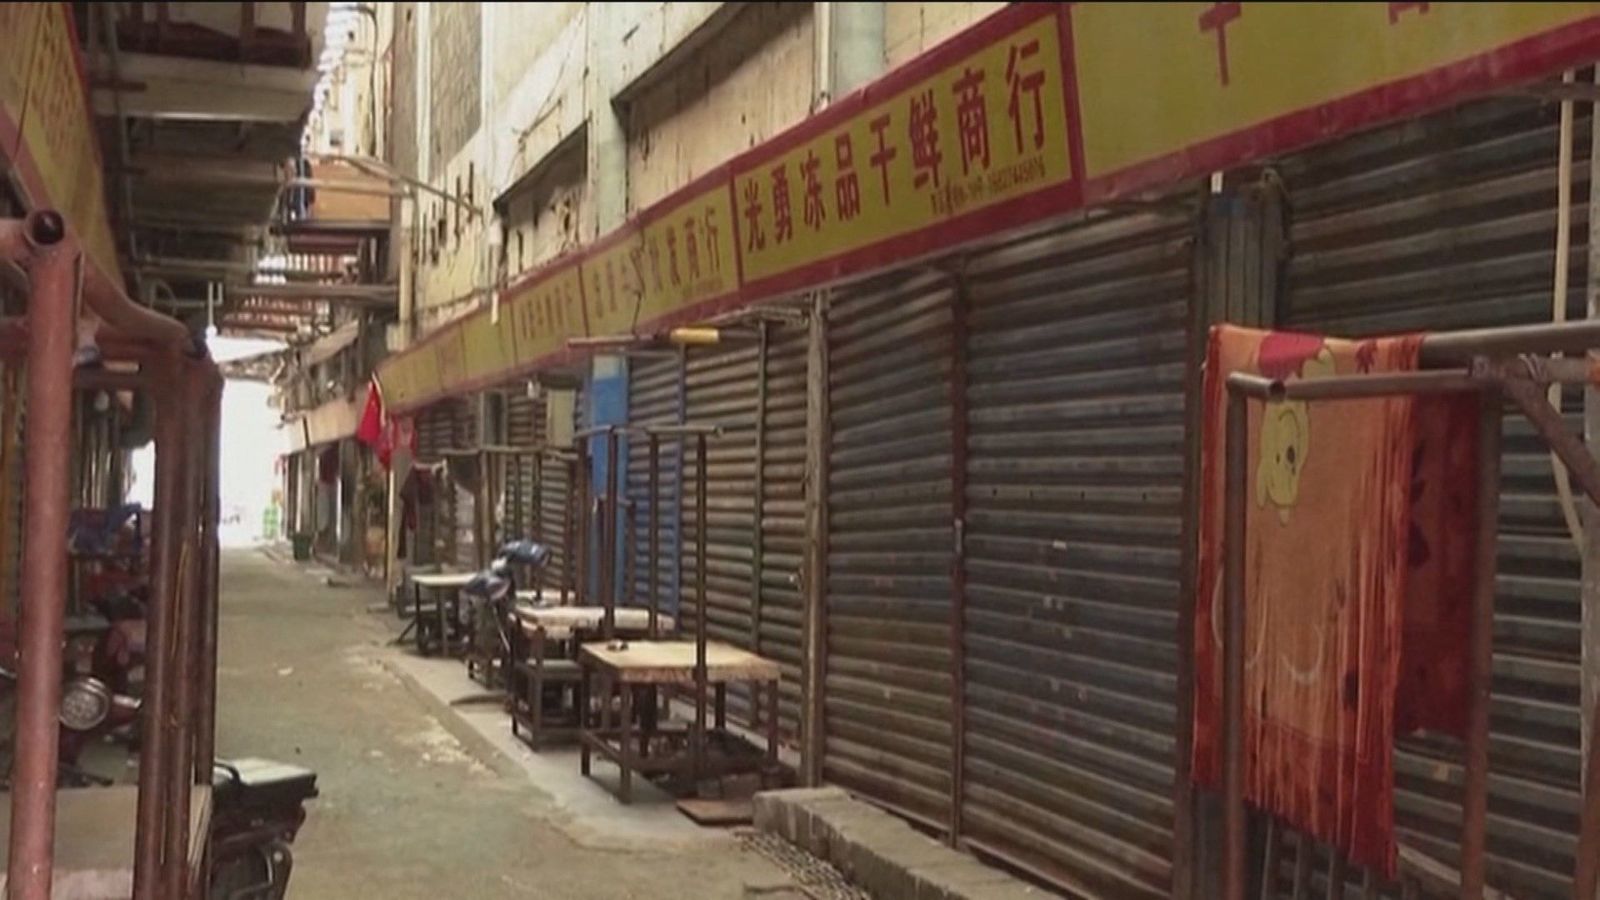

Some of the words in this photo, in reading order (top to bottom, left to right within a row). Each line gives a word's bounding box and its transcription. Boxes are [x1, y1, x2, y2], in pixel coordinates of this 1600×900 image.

[744, 39, 1046, 253] 光勇冻品干鲜商行
